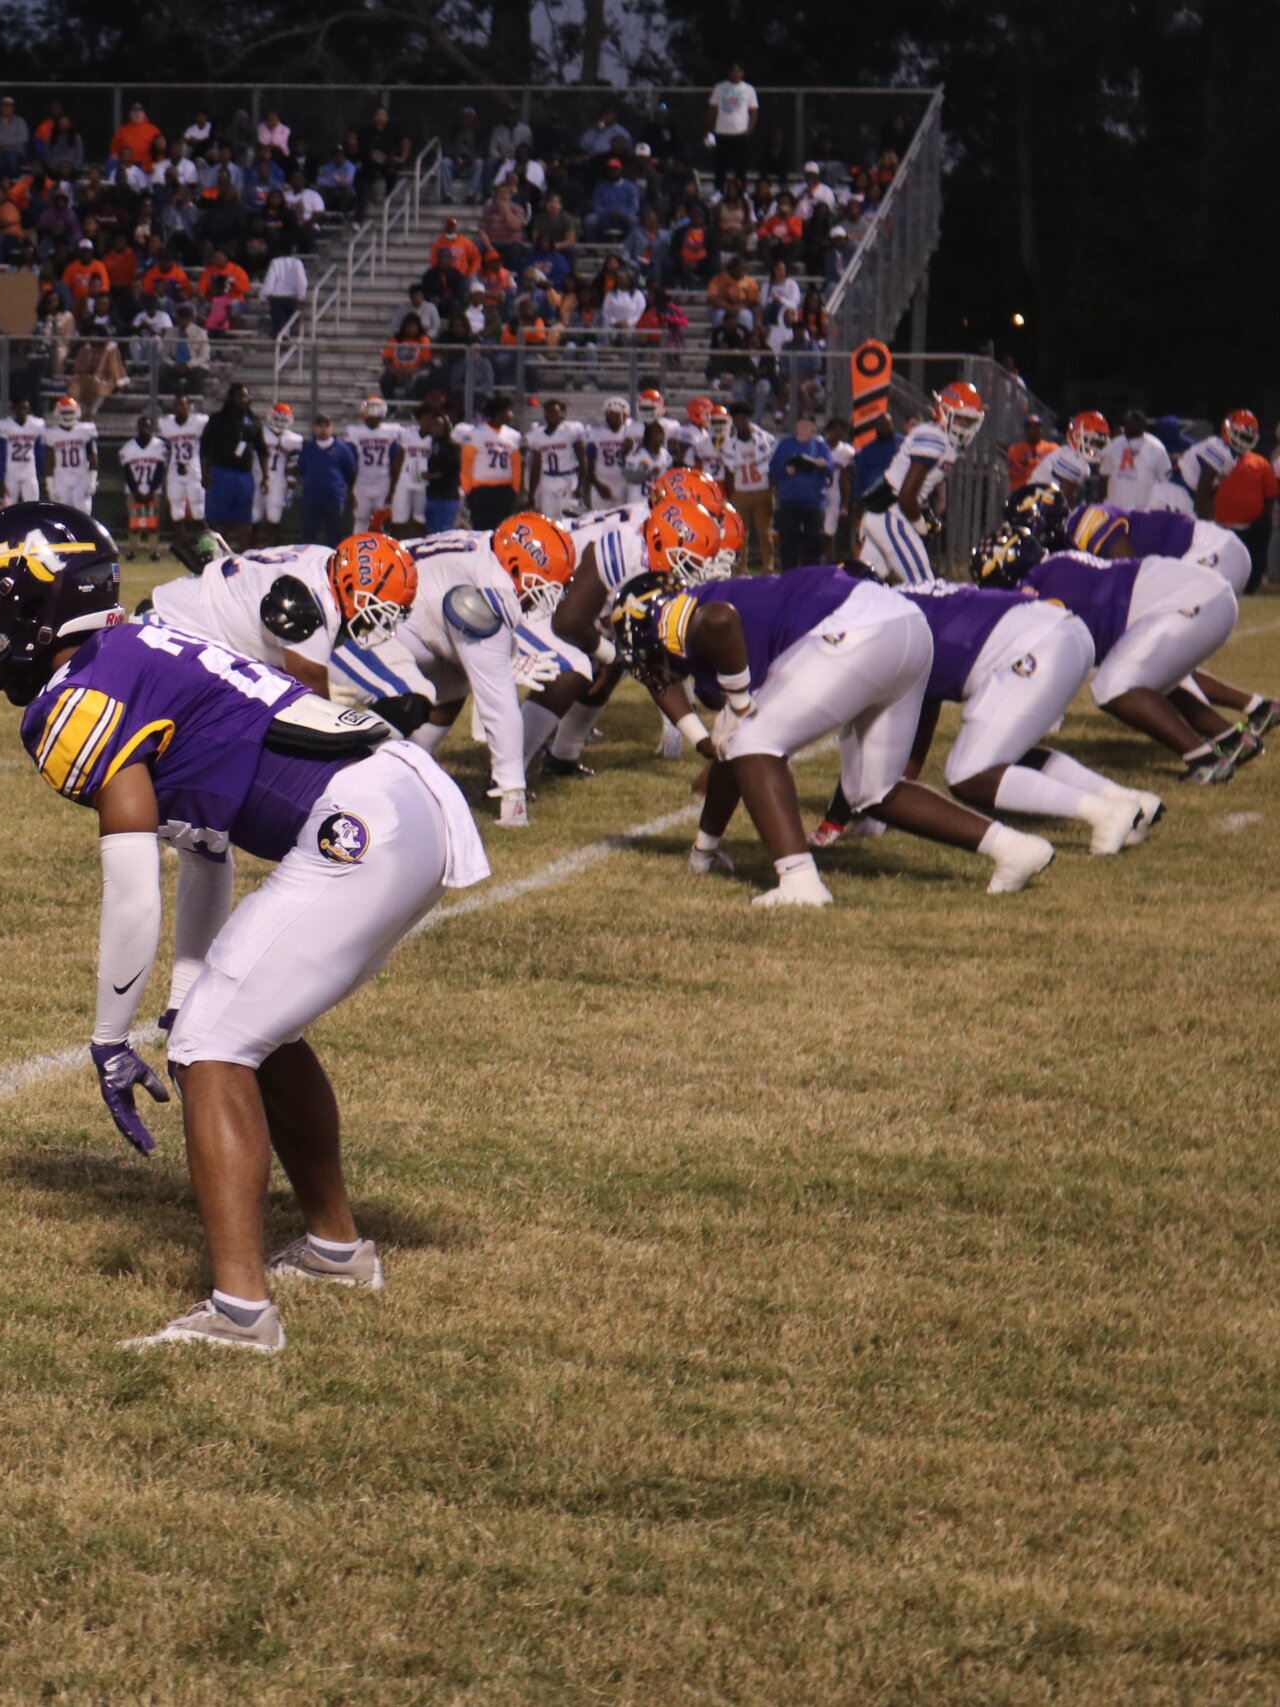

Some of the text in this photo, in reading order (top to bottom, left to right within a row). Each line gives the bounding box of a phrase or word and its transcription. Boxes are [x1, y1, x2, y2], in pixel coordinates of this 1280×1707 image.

[11, 443, 32, 462] 22
[61, 449, 80, 467] 10
[173, 442, 193, 460] 13
[363, 447, 385, 466] 57
[488, 451, 509, 469] 76
[667, 473, 688, 500] Roo
[513, 523, 550, 567] Roos
[355, 537, 378, 587] Roos
